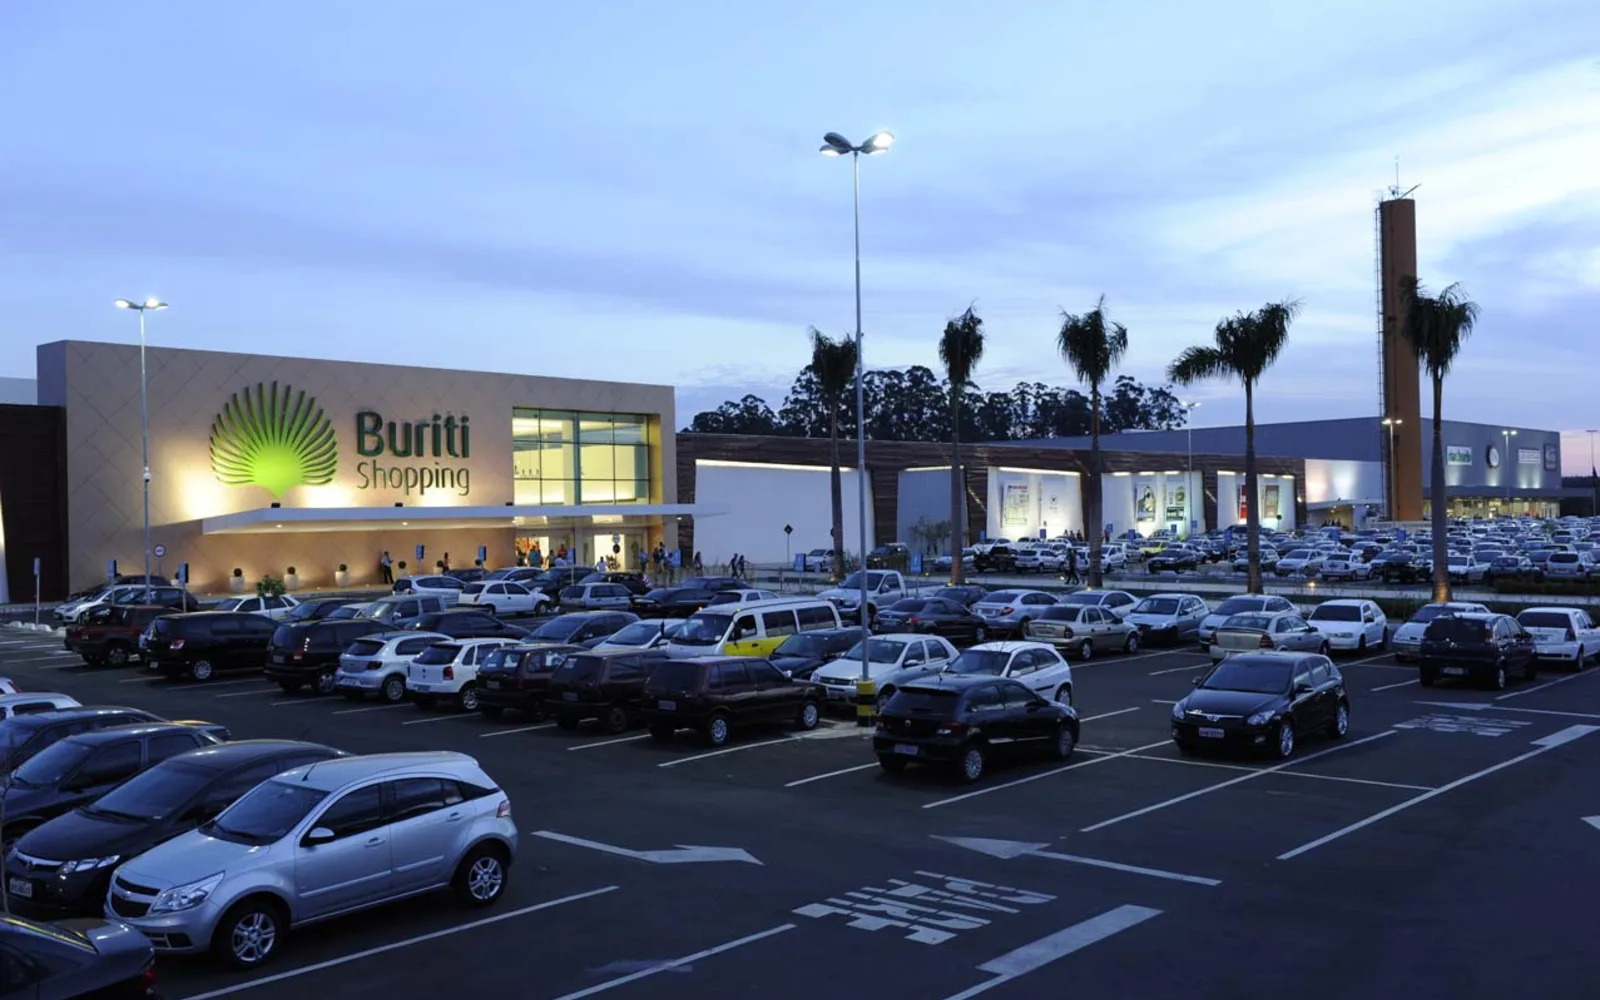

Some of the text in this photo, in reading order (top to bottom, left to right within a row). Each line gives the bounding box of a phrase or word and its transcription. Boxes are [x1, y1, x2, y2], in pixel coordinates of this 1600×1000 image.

[356, 411, 470, 458] Buriti
[356, 459, 470, 496] Shopping
[791, 870, 1058, 946] PARE
